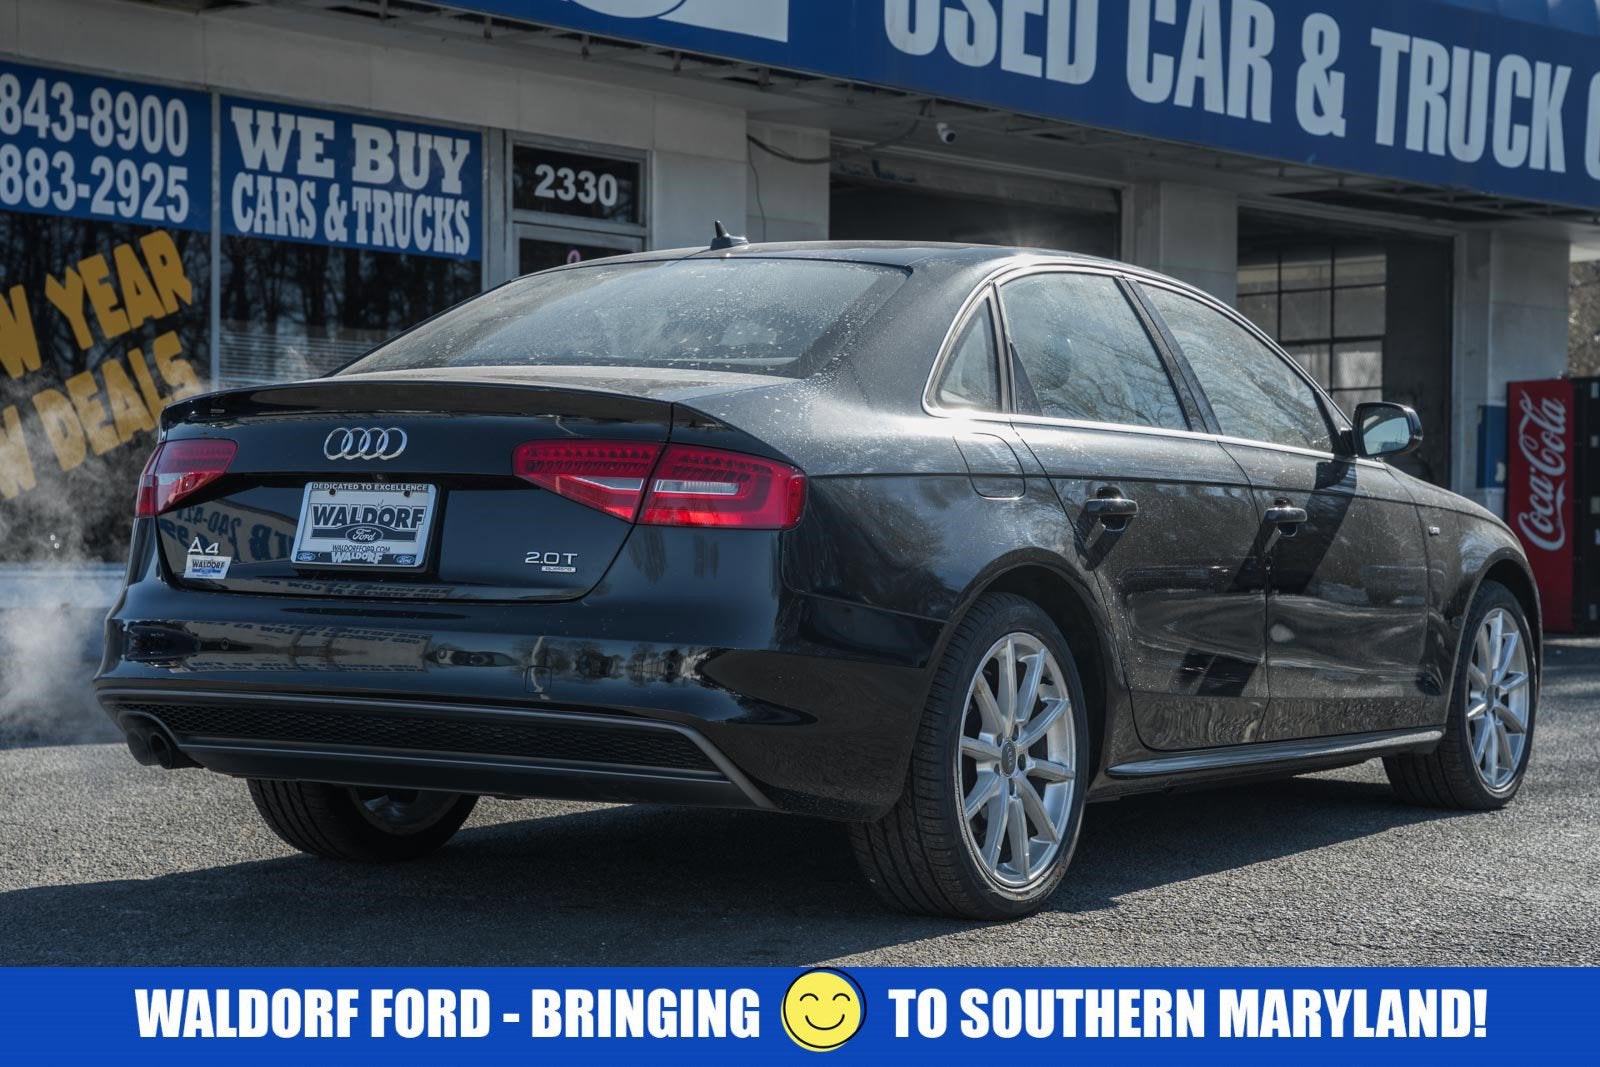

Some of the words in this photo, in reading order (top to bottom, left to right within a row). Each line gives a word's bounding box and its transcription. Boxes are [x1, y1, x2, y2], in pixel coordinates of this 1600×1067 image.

[0, 73, 189, 157] 843-8900
[1126, 0, 1275, 124] CAR
[1296, 13, 1346, 138] &
[1371, 28, 1572, 174] TRUCK
[0, 143, 189, 223] 883-2925
[231, 106, 335, 179] WE
[352, 123, 470, 194] BUY
[232, 171, 317, 240] CARS
[534, 164, 618, 206] 2330
[45, 230, 192, 350] YEAR
[32, 330, 201, 472] DEALS
[188, 536, 220, 555] A4
[311, 504, 427, 531] WALDORF
[352, 527, 377, 541] Ford
[191, 559, 225, 569] WALDORF
[331, 551, 384, 564] WALDORF
